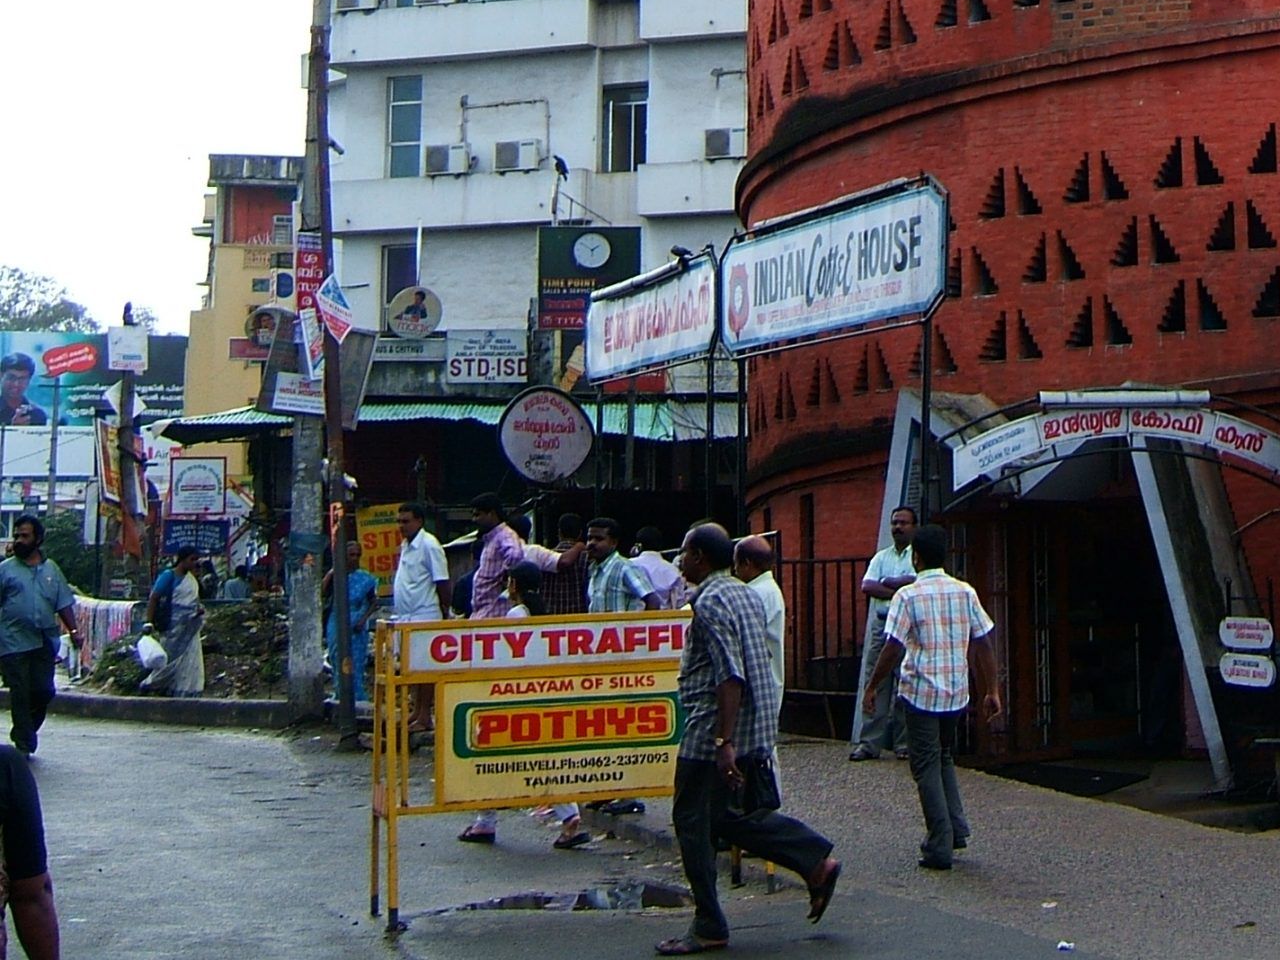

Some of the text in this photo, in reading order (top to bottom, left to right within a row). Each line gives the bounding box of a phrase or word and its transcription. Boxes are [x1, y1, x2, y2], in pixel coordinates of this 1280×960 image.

[753, 248, 806, 307] INDIAN
[857, 215, 922, 281] HOUSE
[543, 278, 595, 287] TIME POINT
[557, 316, 585, 325] TITA
[450, 358, 528, 377] STD-ISD
[1131, 409, 1204, 435] കോഫി
[430, 623, 686, 664] CITY TRAFFI
[490, 674, 655, 696] AALAYAM OF SILKS
[476, 704, 668, 745] POTHYS
[524, 771, 623, 788] TAMILNADU
